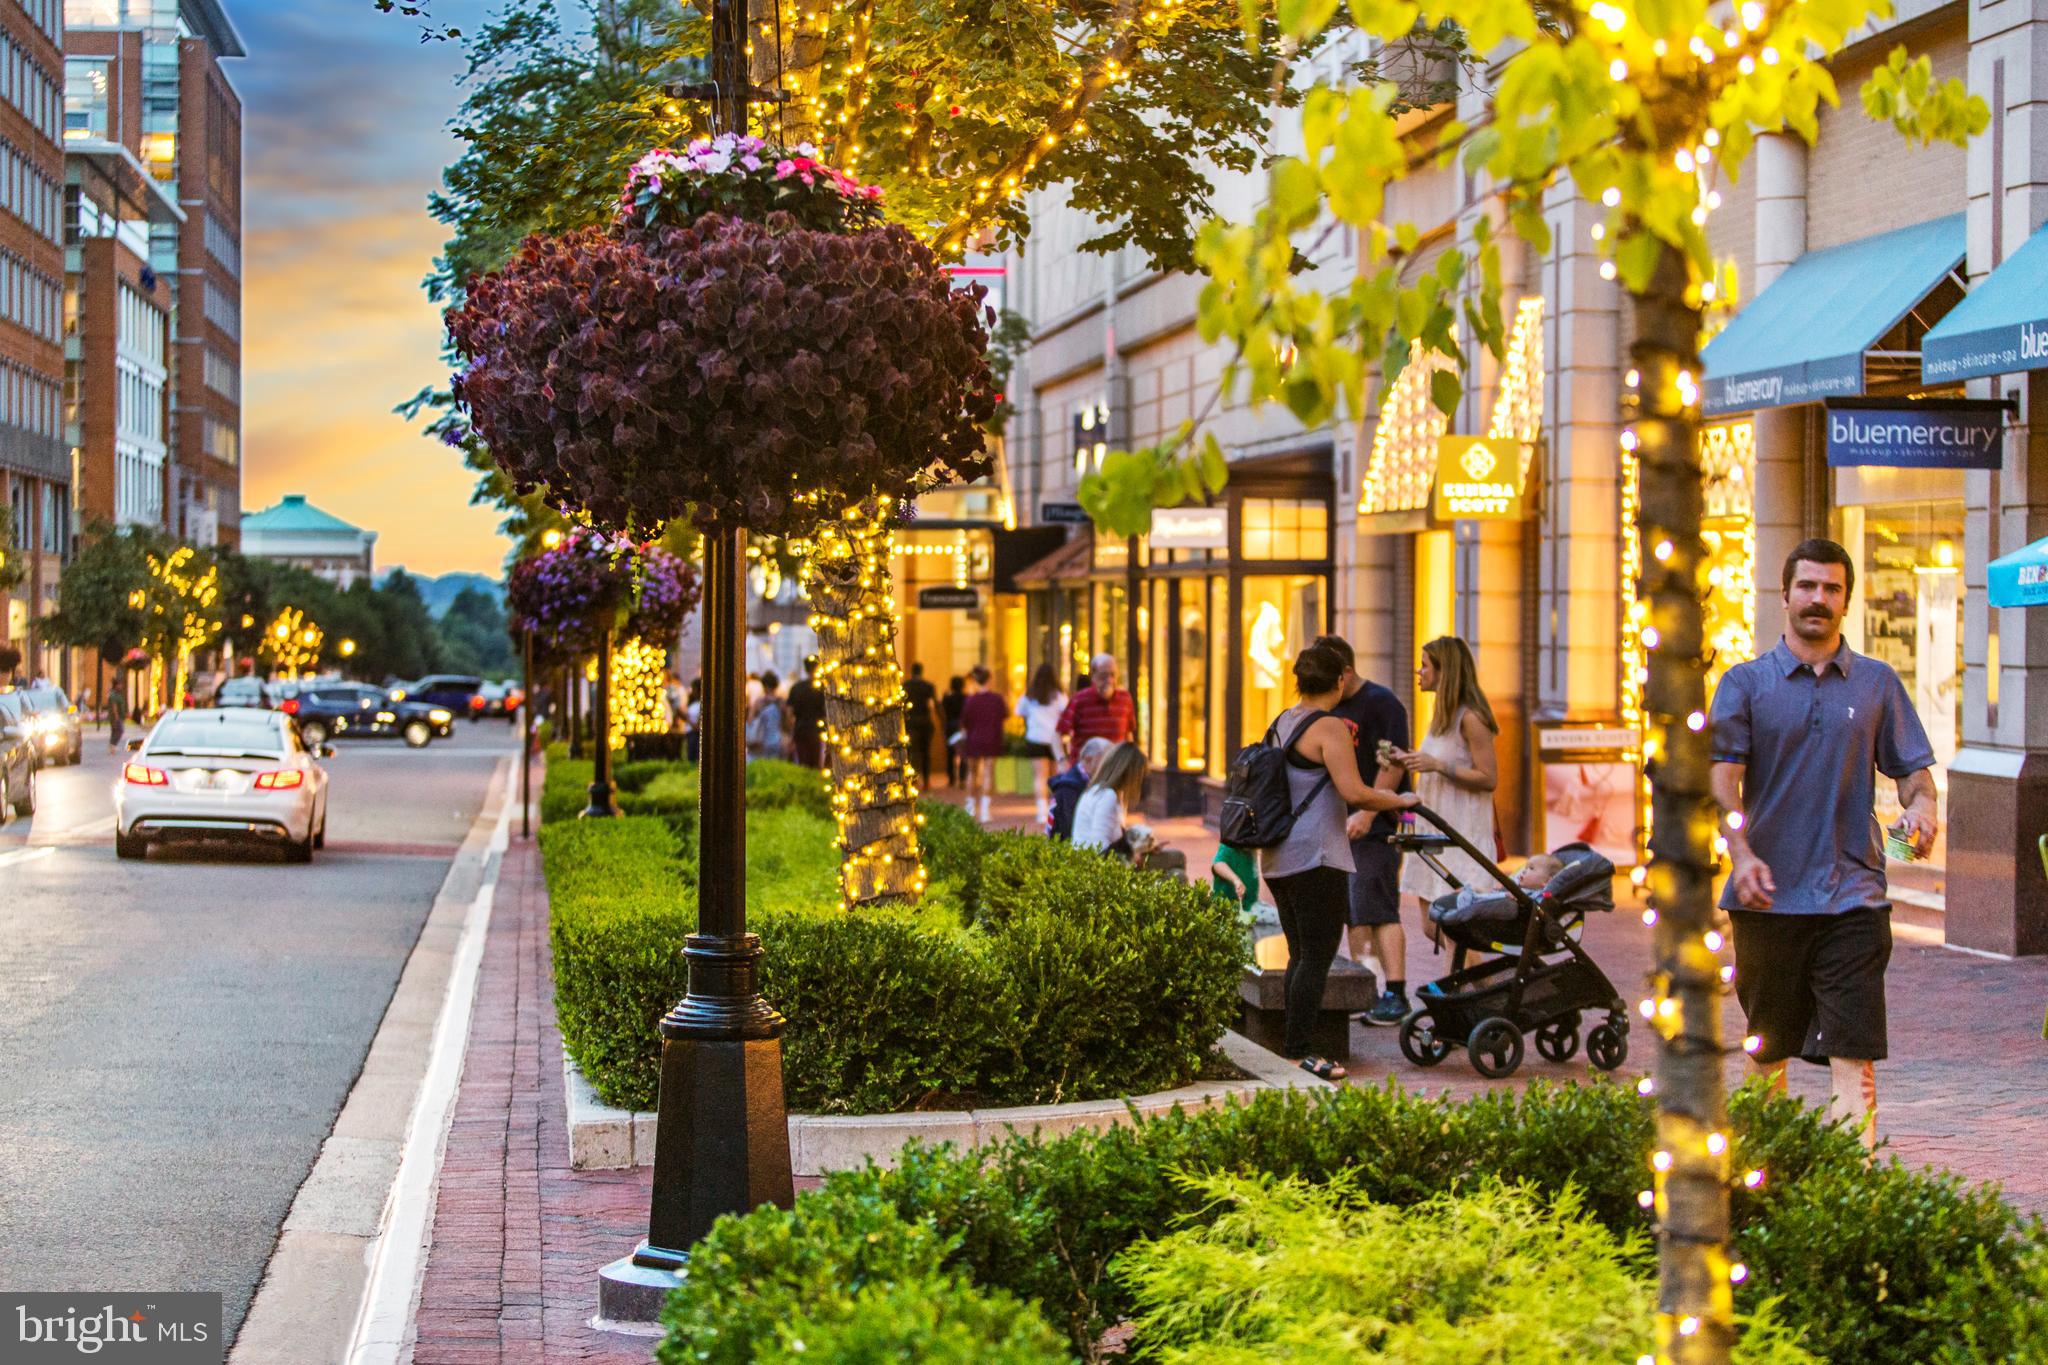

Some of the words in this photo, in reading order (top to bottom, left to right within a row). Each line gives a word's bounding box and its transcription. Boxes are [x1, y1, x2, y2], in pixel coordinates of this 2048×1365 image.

[1962, 352, 1997, 369] skincare
[2001, 349, 2017, 366] spa
[1725, 375, 1783, 405] bluemercury
[1832, 415, 1997, 452] bluemercury
[1449, 499, 1509, 513] SCOTT
